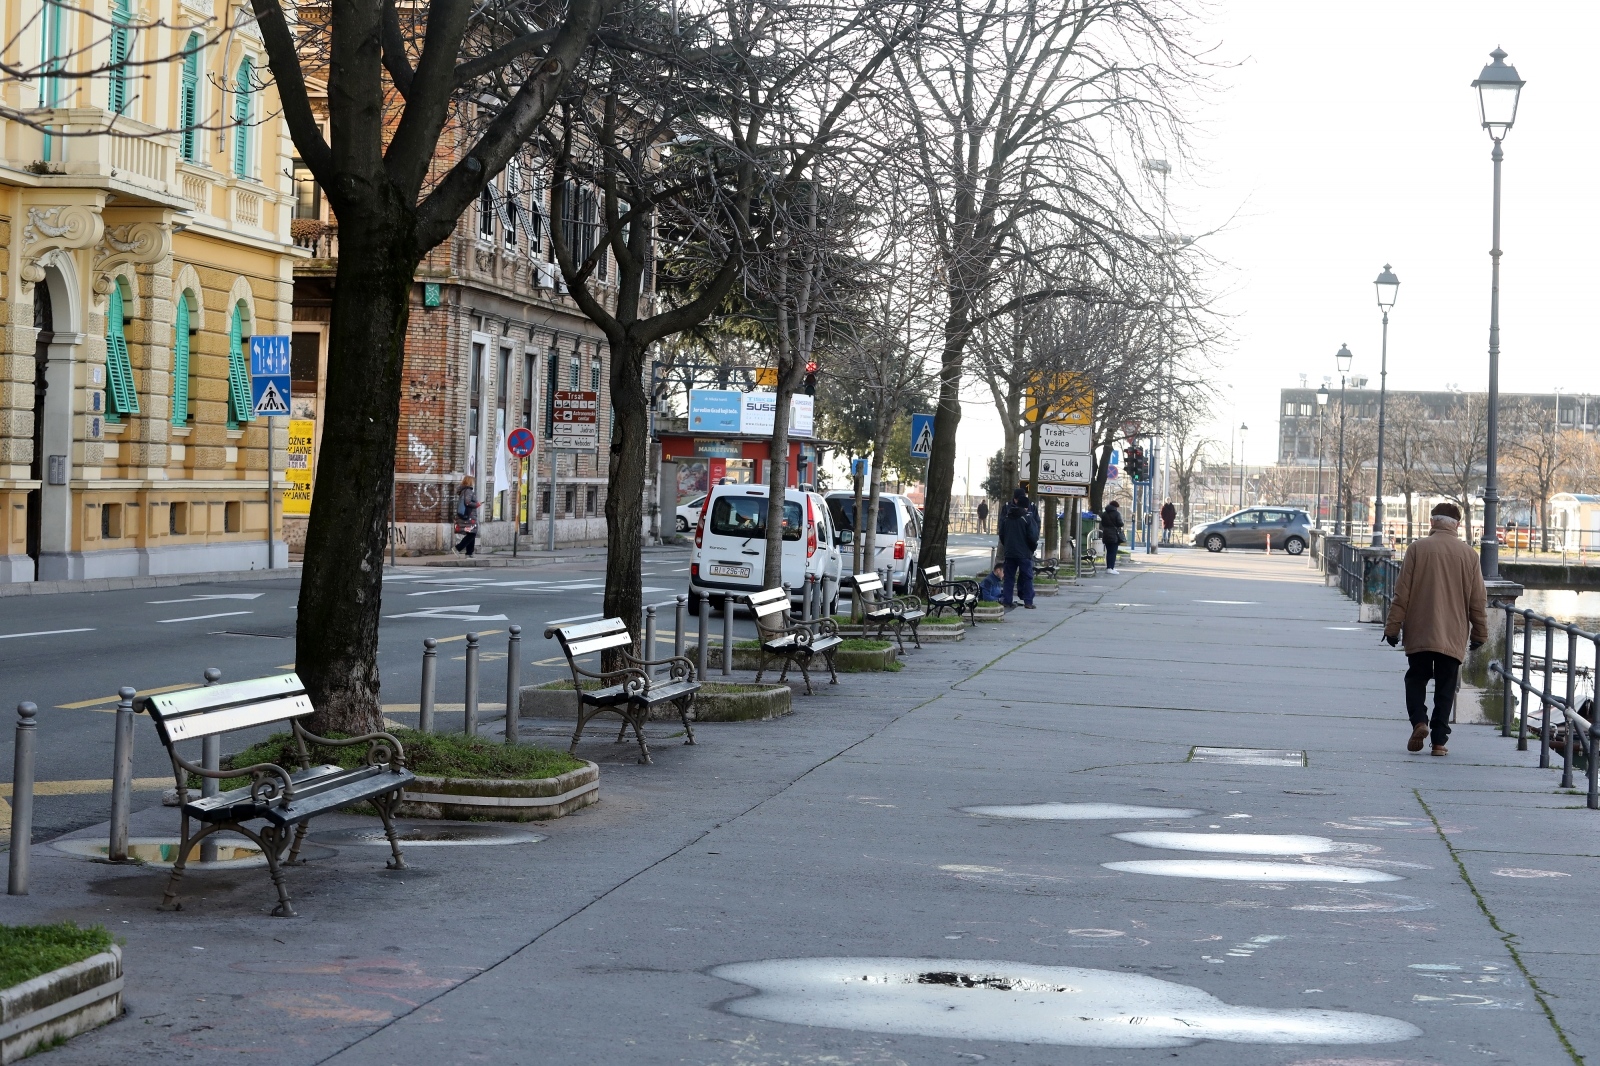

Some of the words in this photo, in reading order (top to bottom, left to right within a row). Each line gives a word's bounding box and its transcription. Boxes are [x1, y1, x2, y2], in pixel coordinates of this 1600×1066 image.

[289, 436, 305, 445] OŽNE
[1045, 439, 1069, 447] Vežica
[1062, 470, 1083, 478] Sušak
[291, 492, 310, 500] JAKNE
